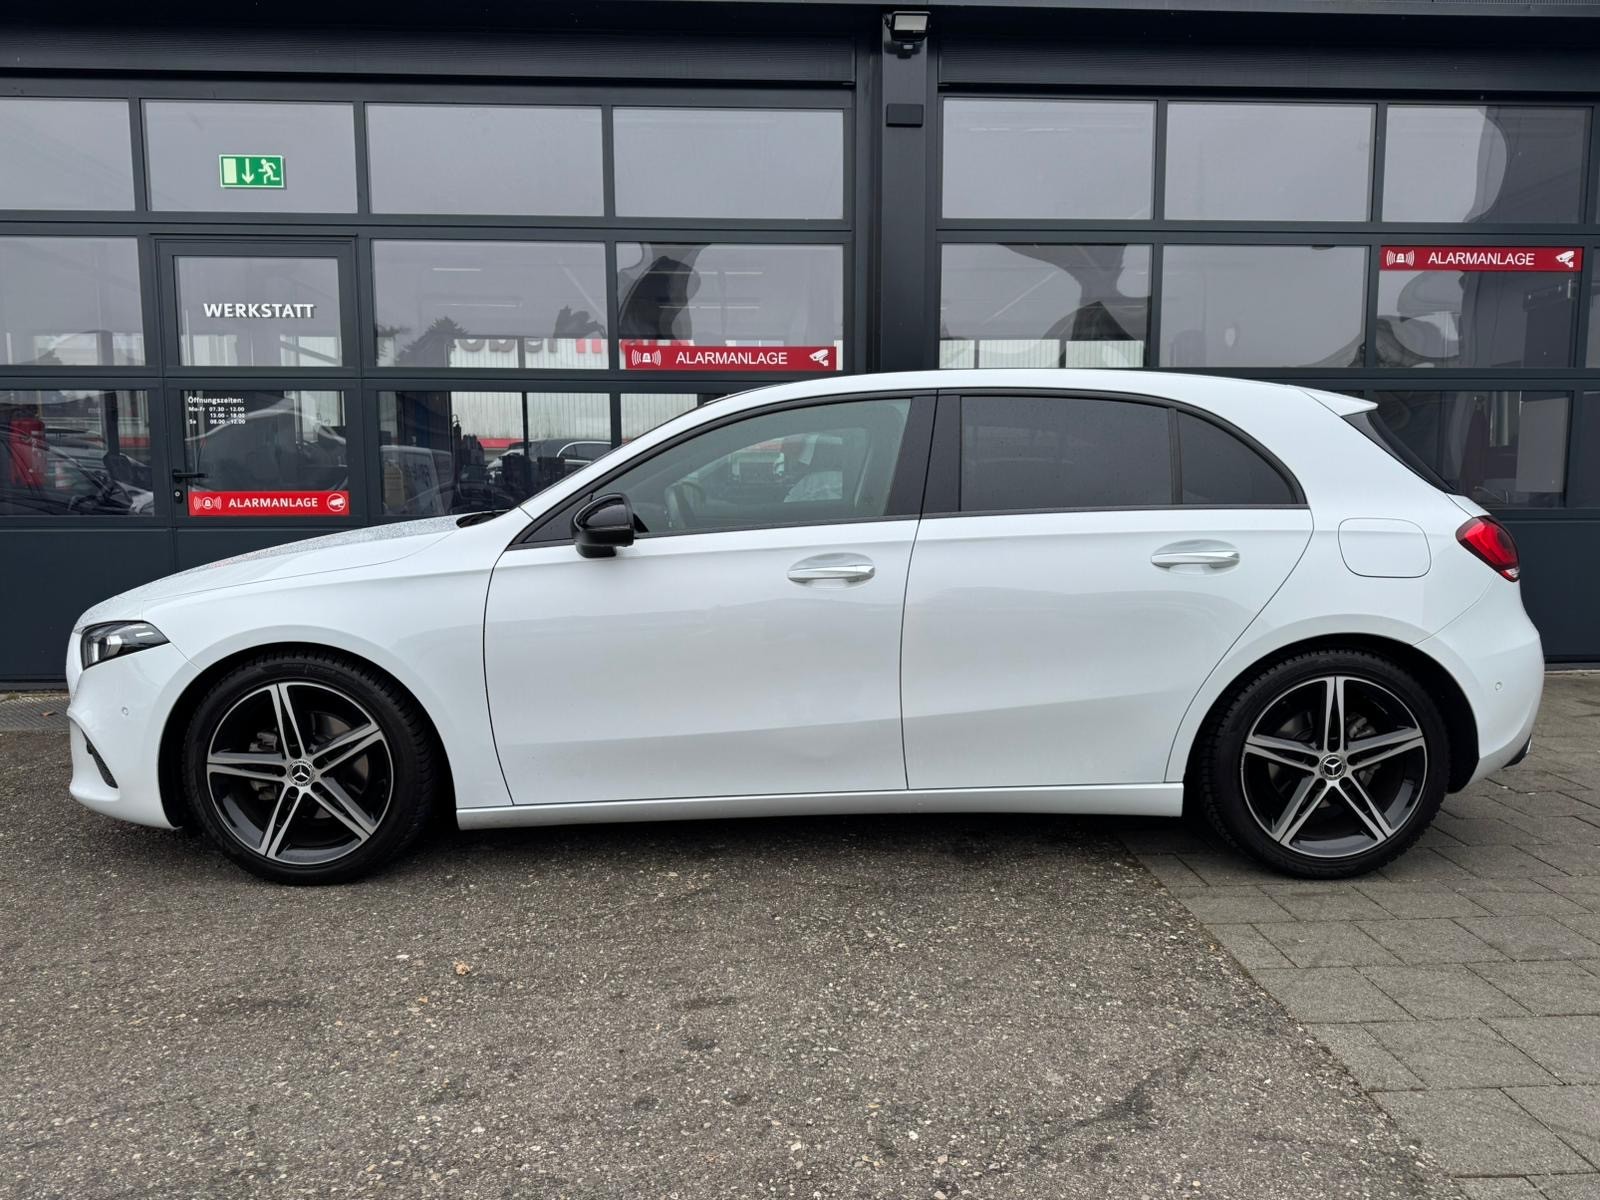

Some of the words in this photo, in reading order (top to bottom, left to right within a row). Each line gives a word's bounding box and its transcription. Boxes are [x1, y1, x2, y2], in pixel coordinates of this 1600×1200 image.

[1427, 252, 1535, 266] ALARMANLAGE
[203, 303, 315, 318] WERKSTATT
[675, 352, 788, 365] ALARMANLAGE
[188, 396, 244, 405] Öffnungszeiten:
[228, 498, 318, 508] ALARMANLAGE
